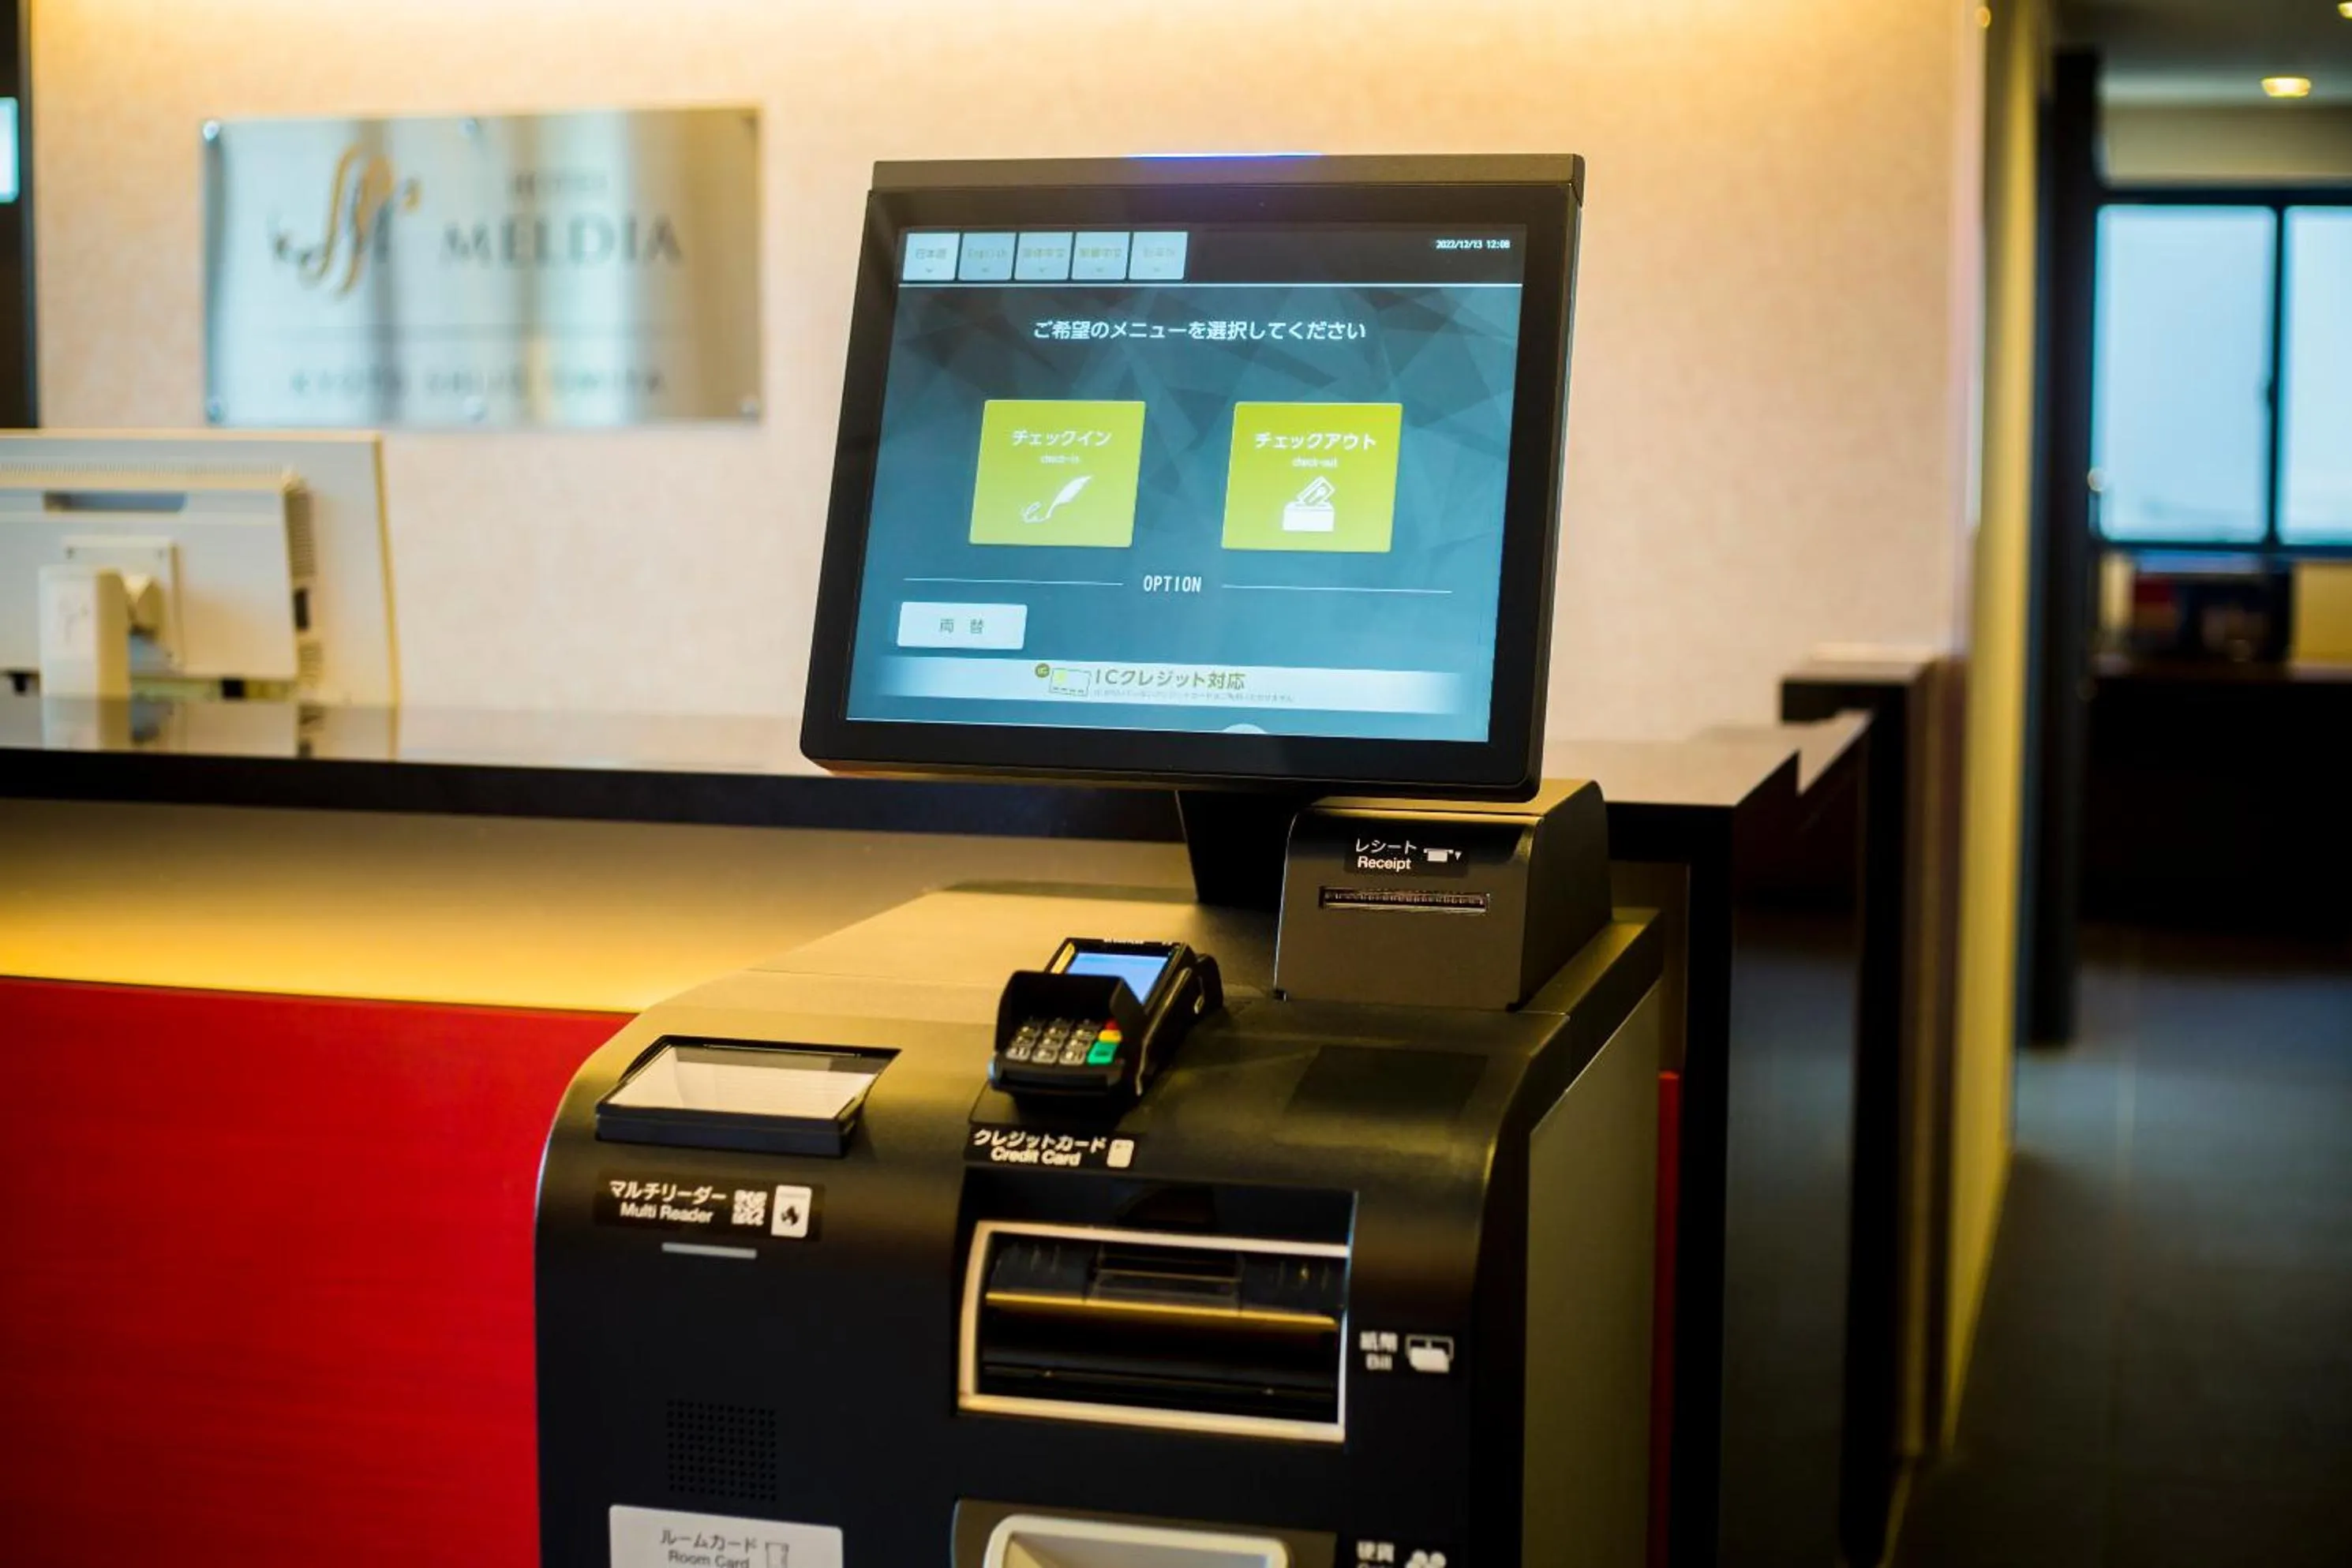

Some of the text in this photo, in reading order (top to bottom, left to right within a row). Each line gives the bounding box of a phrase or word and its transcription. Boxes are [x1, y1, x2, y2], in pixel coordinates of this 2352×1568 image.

[440, 211, 684, 267] MELDIA
[1033, 320, 1366, 340] ご希望のメニューを選択してください
[1012, 429, 1113, 448] チェックイン
[1255, 432, 1377, 451] チェックアウト
[1143, 574, 1202, 593] OPTION
[1355, 838, 1418, 855] レシート
[1357, 855, 1412, 872] Receipt
[973, 1129, 1107, 1153] クレジットカード
[991, 1147, 1082, 1166] Credit Card
[609, 1180, 727, 1205] マルチリーダー
[620, 1202, 713, 1224] Multi Reader
[661, 1529, 758, 1552] ルームカード
[668, 1549, 750, 1568] Room Card
